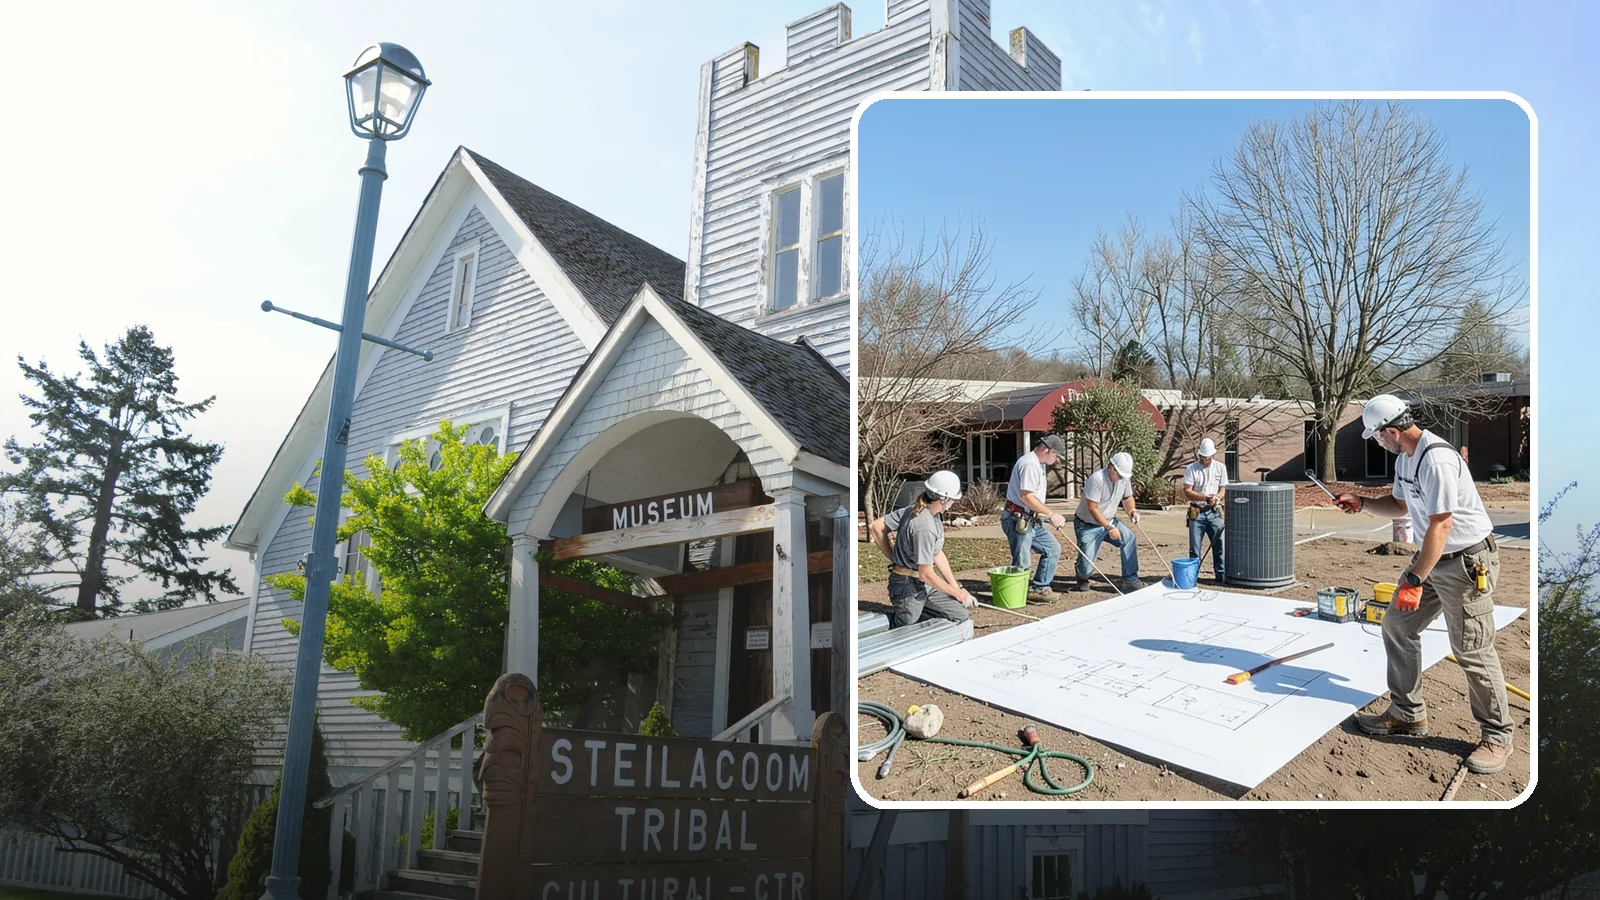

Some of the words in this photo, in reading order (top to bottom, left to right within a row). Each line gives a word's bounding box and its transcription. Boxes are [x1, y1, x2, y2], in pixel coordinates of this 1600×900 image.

[613, 491, 713, 530] MUSEUM
[551, 739, 809, 792] STEILACOOM
[615, 807, 757, 852] TRIBAL
